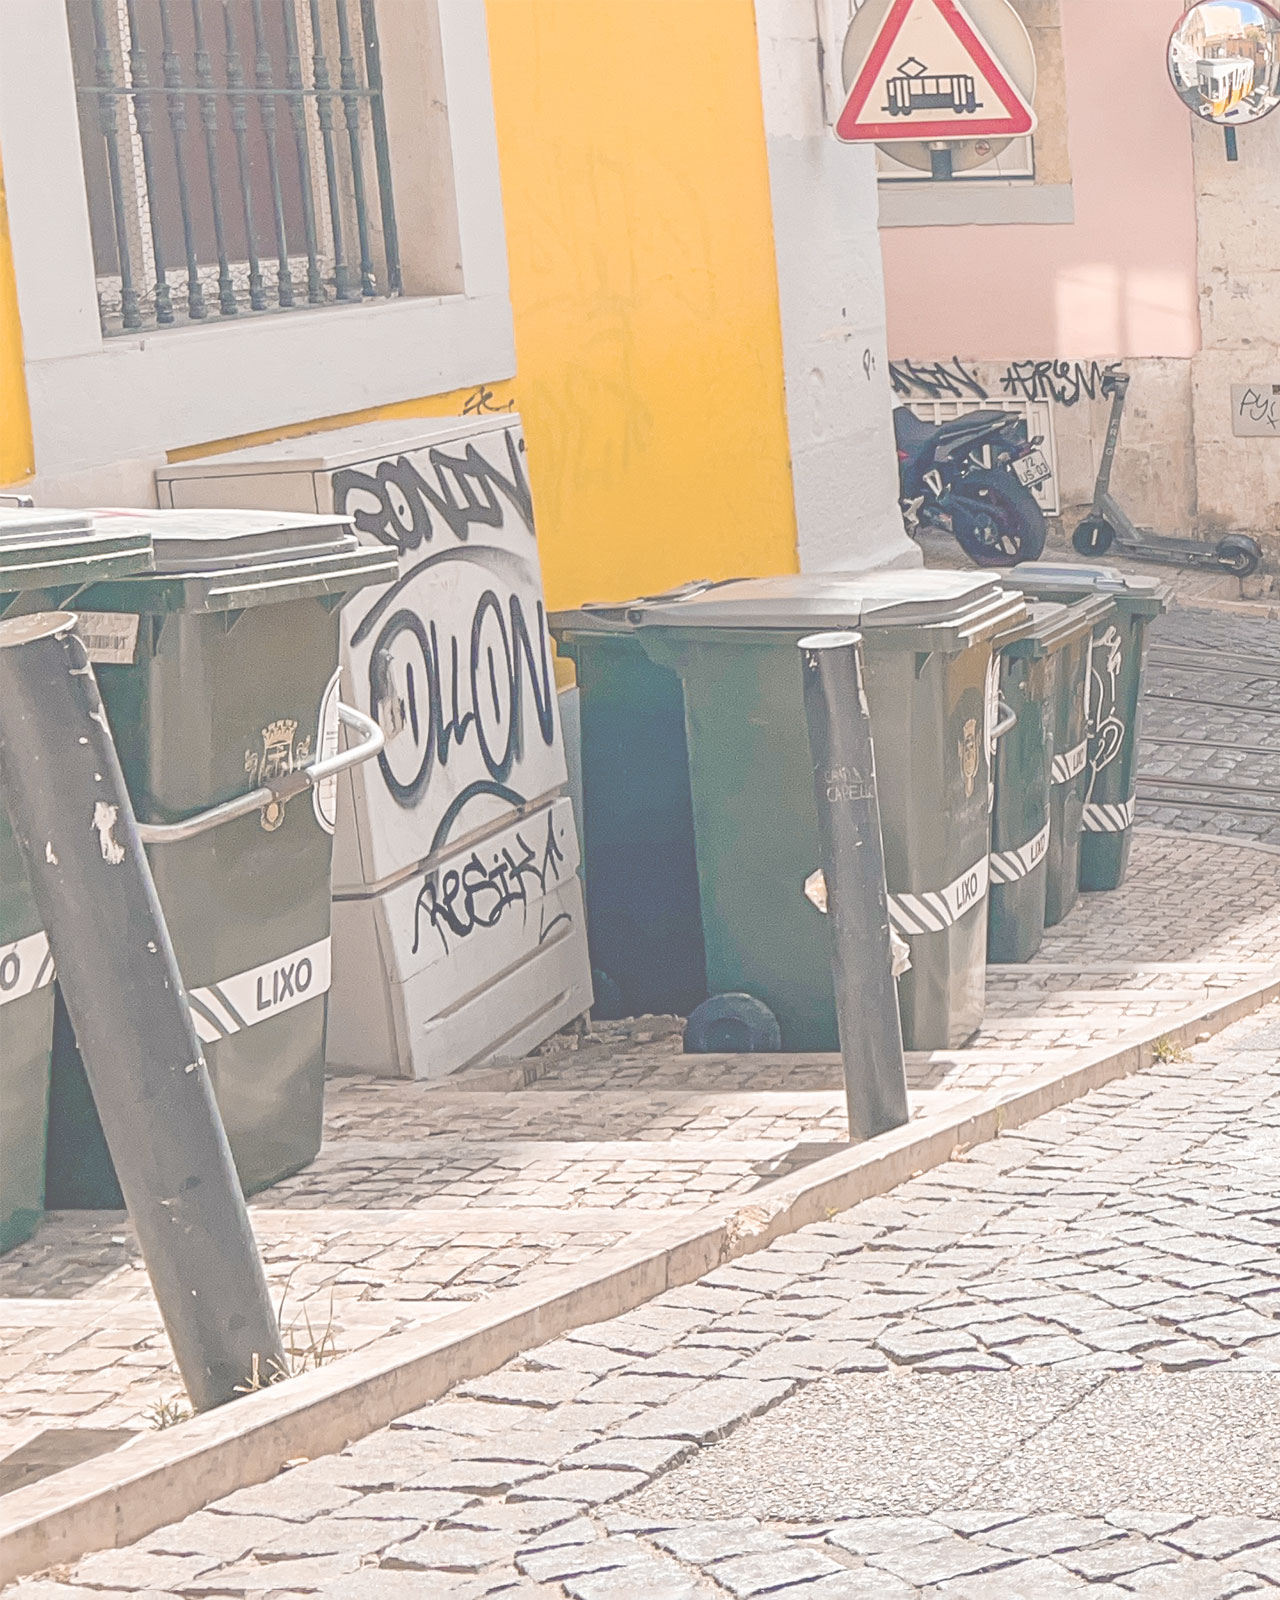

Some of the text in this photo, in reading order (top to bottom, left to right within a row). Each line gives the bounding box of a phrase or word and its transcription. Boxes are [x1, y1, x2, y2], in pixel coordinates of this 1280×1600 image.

[1022, 457, 1036, 469] 72
[956, 872, 978, 910] LIXO
[256, 957, 312, 1012] LIXO
